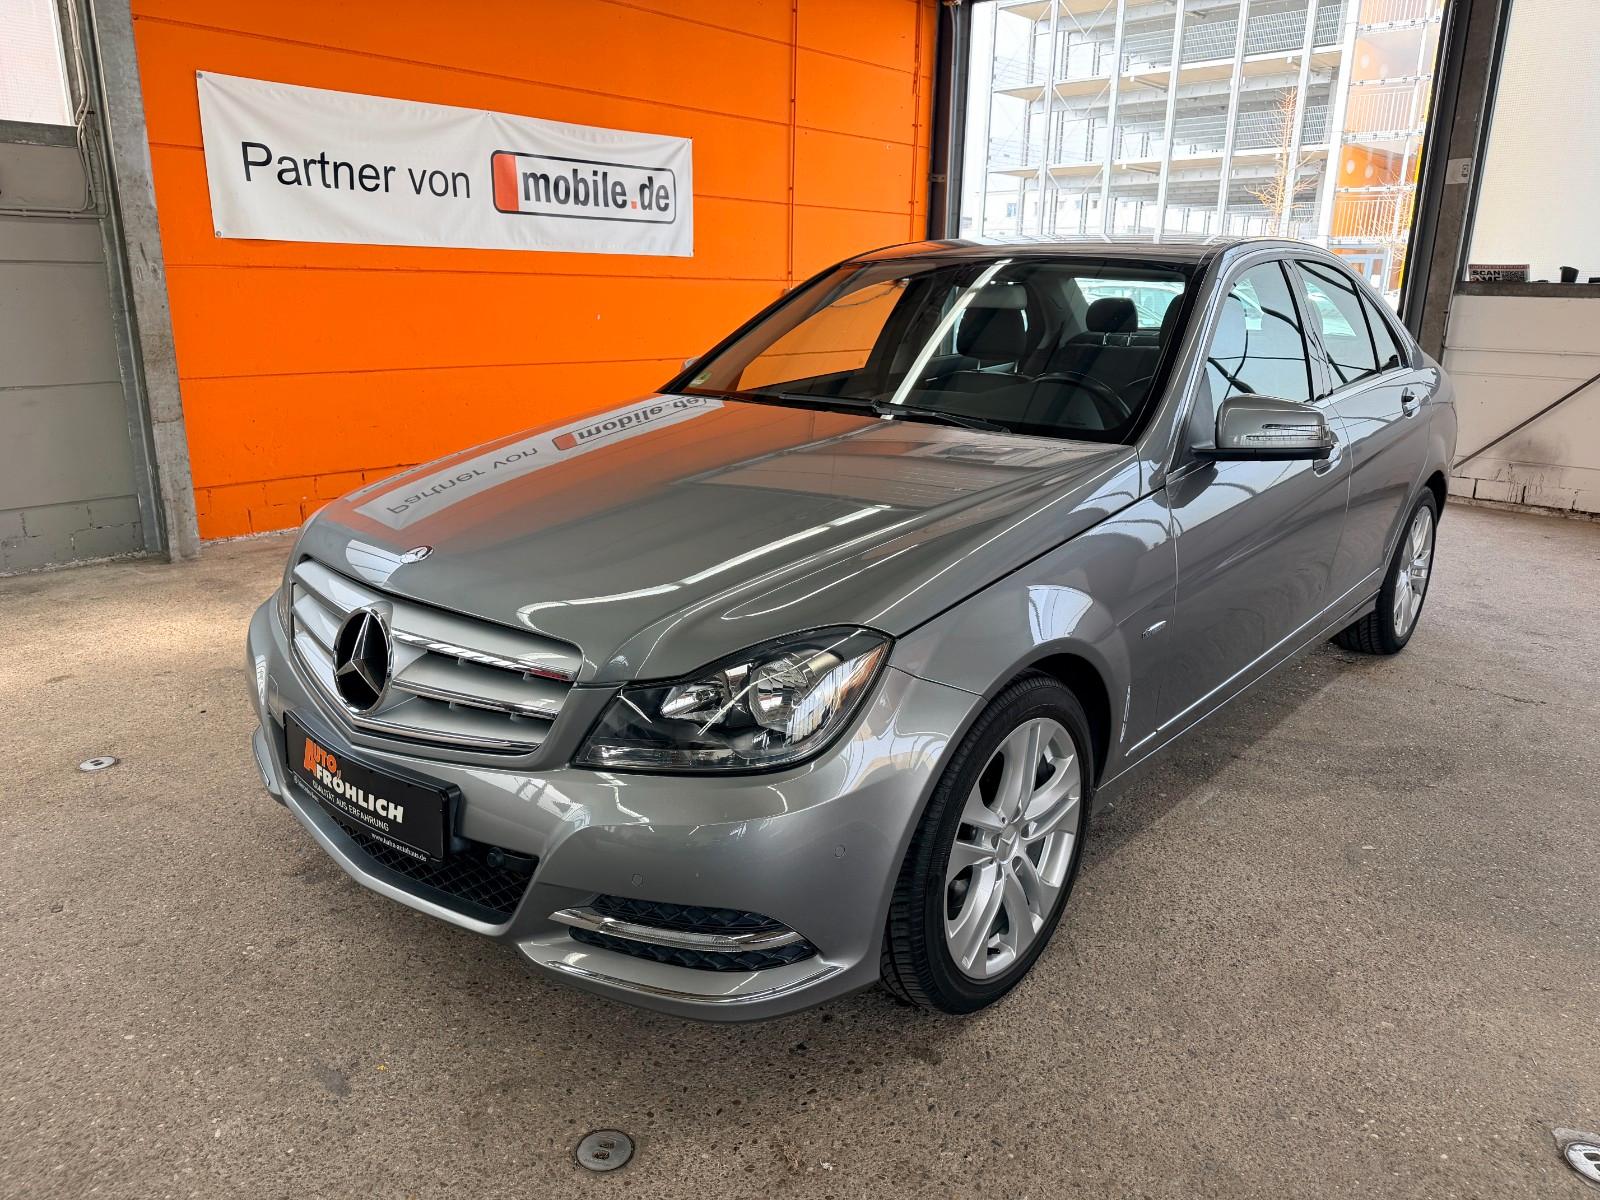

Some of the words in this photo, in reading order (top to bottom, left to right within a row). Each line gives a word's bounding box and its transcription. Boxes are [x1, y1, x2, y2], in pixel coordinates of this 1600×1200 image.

[241, 141, 396, 193] Partner
[408, 168, 471, 198] von
[522, 168, 670, 212] mobile.de
[316, 763, 404, 824] FRÖHLICH
[348, 804, 390, 832] ERFAHRUNG
